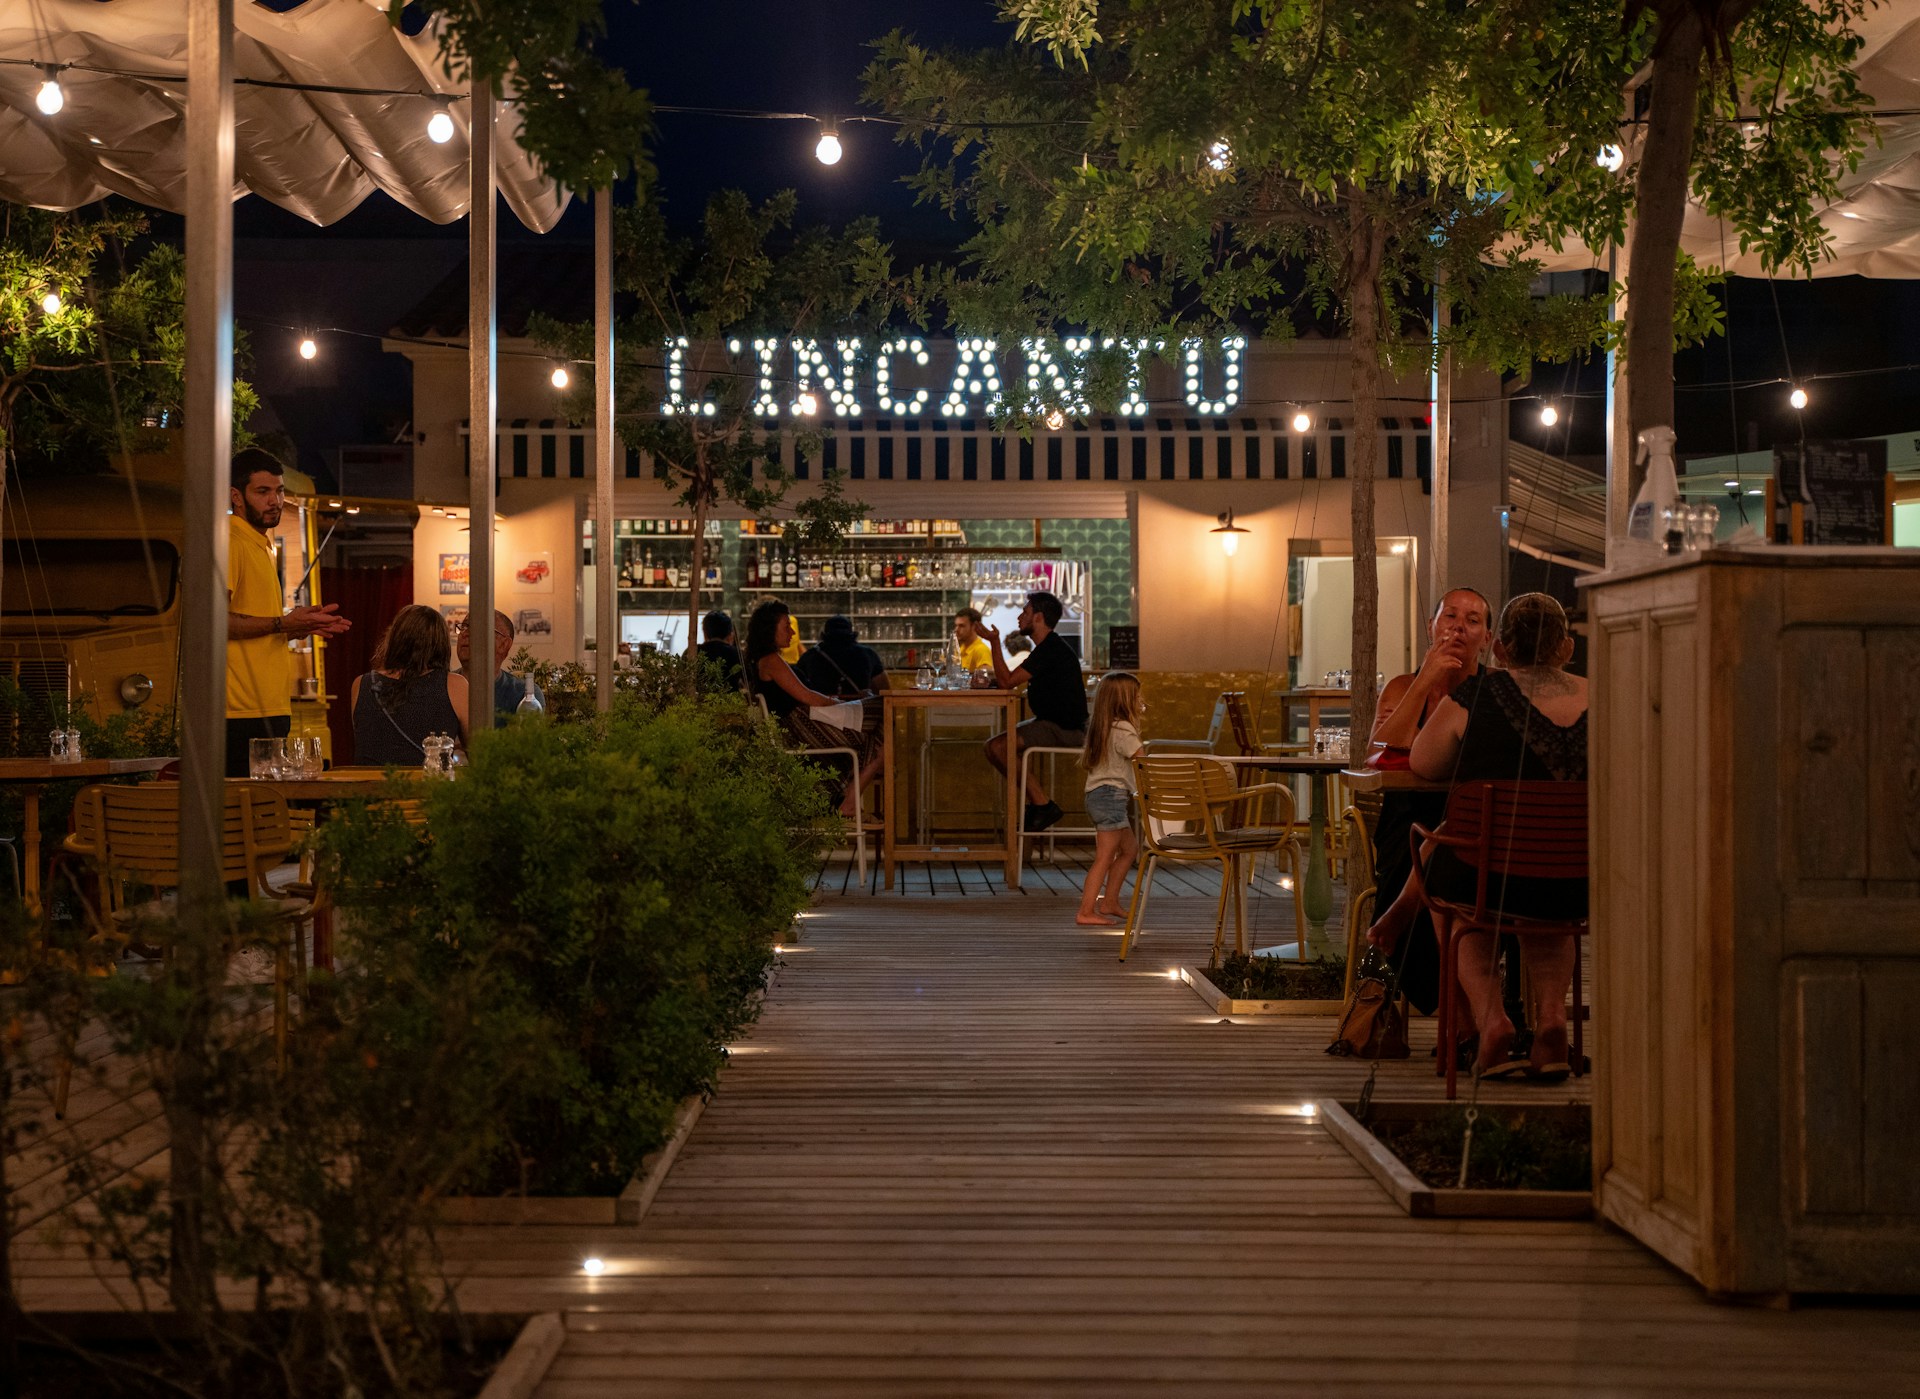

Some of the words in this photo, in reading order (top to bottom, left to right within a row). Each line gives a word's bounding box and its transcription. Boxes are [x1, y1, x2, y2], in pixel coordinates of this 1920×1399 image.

[661, 336, 1248, 416] L'INCANTU
[442, 567, 469, 580] BOISSO
[441, 579, 469, 592] FRAIC
